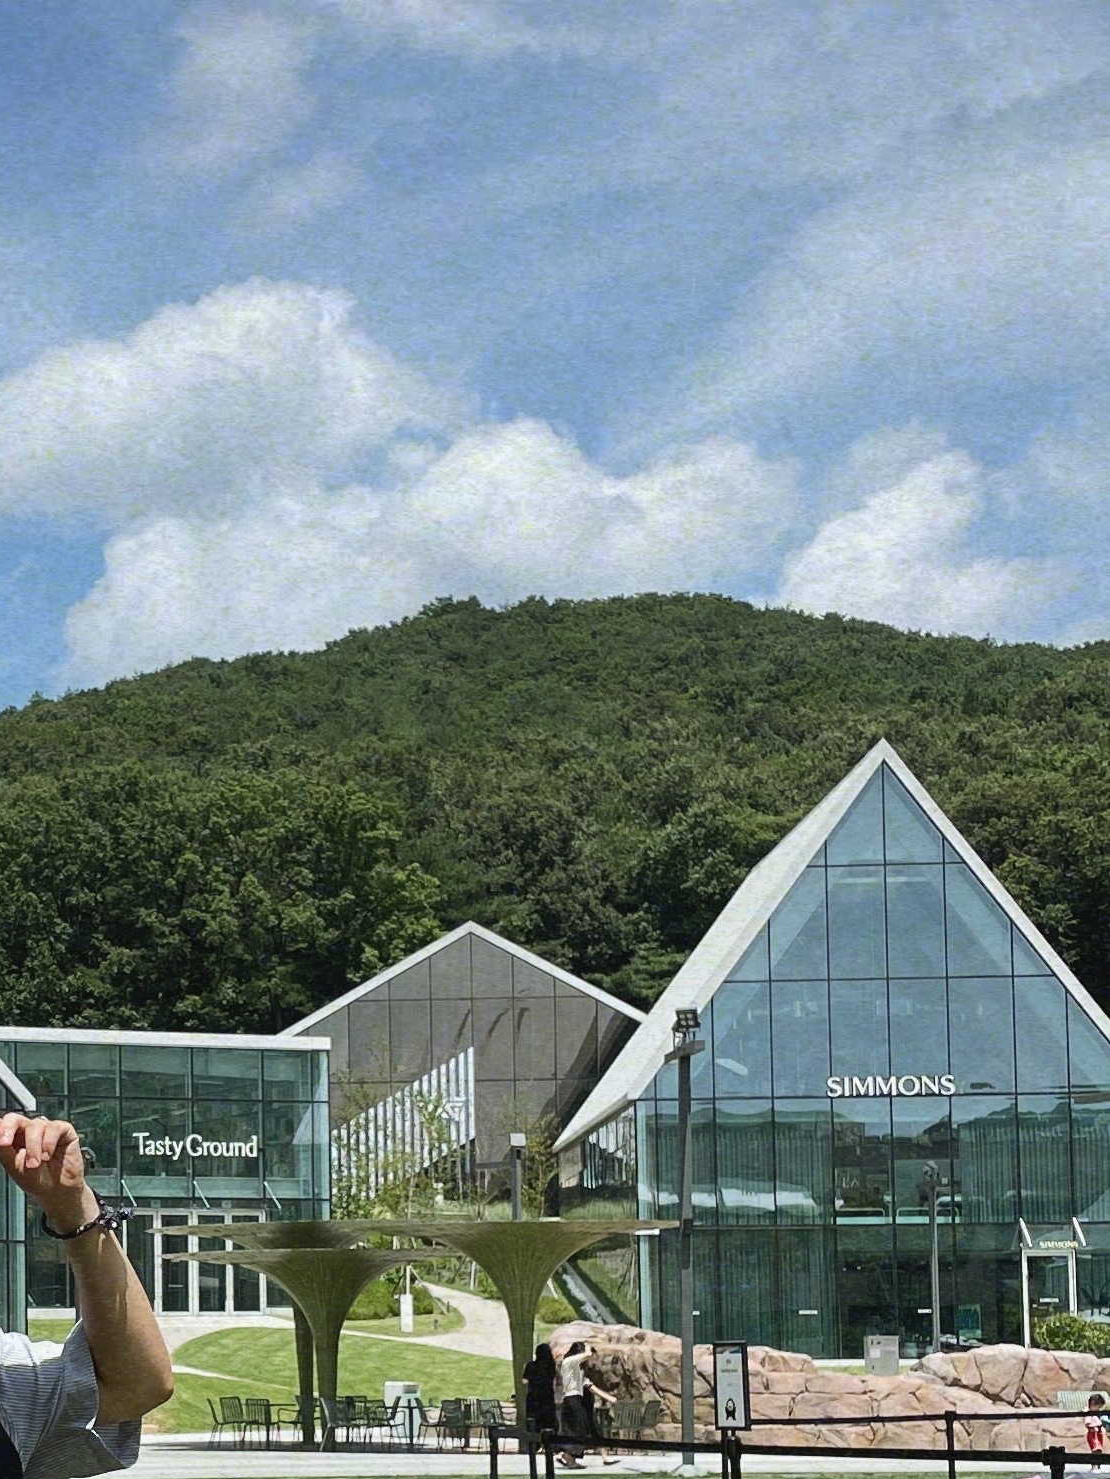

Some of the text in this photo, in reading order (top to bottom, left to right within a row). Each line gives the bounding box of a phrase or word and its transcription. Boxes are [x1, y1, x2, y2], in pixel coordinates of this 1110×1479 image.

[826, 1074, 957, 1098] SIMMONS
[132, 1131, 259, 1161] Tasty Ground
